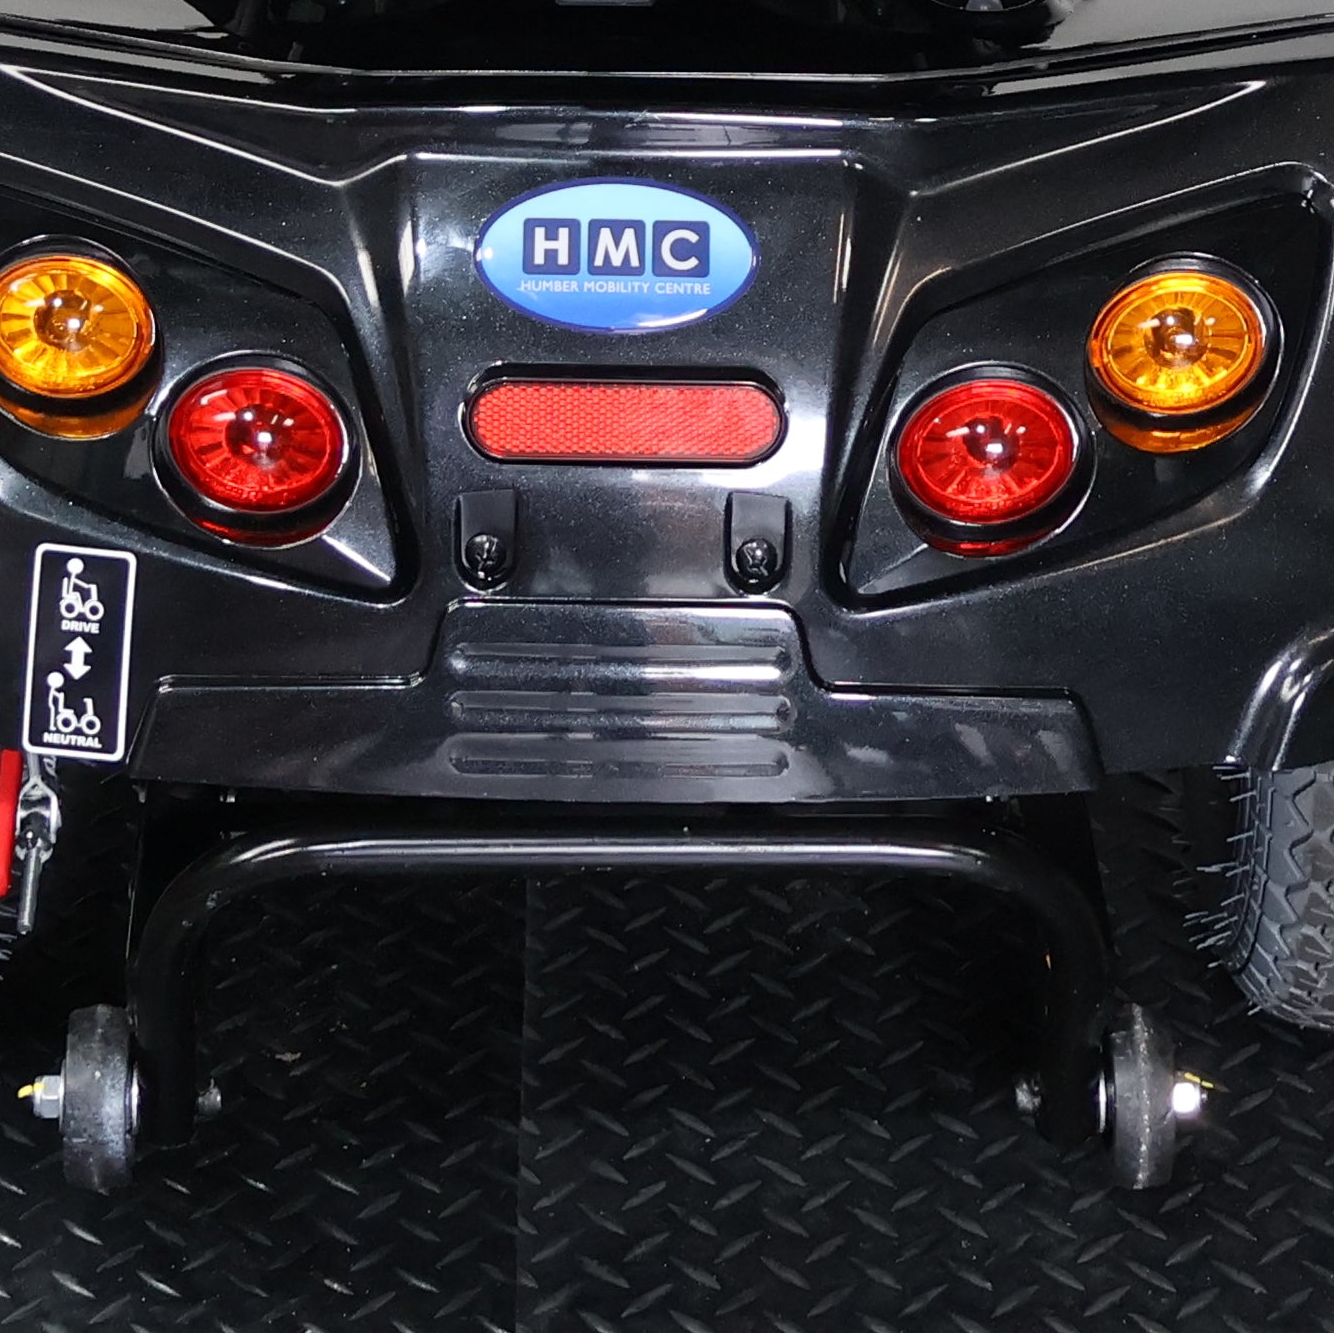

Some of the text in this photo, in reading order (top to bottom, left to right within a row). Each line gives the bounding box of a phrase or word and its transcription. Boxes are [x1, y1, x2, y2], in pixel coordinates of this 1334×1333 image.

[533, 226, 700, 271] HMC
[520, 279, 711, 295] HUMBER MOBILITY CENTRE
[61, 619, 100, 634] DRIVE
[43, 732, 103, 749] NEUTRAL
